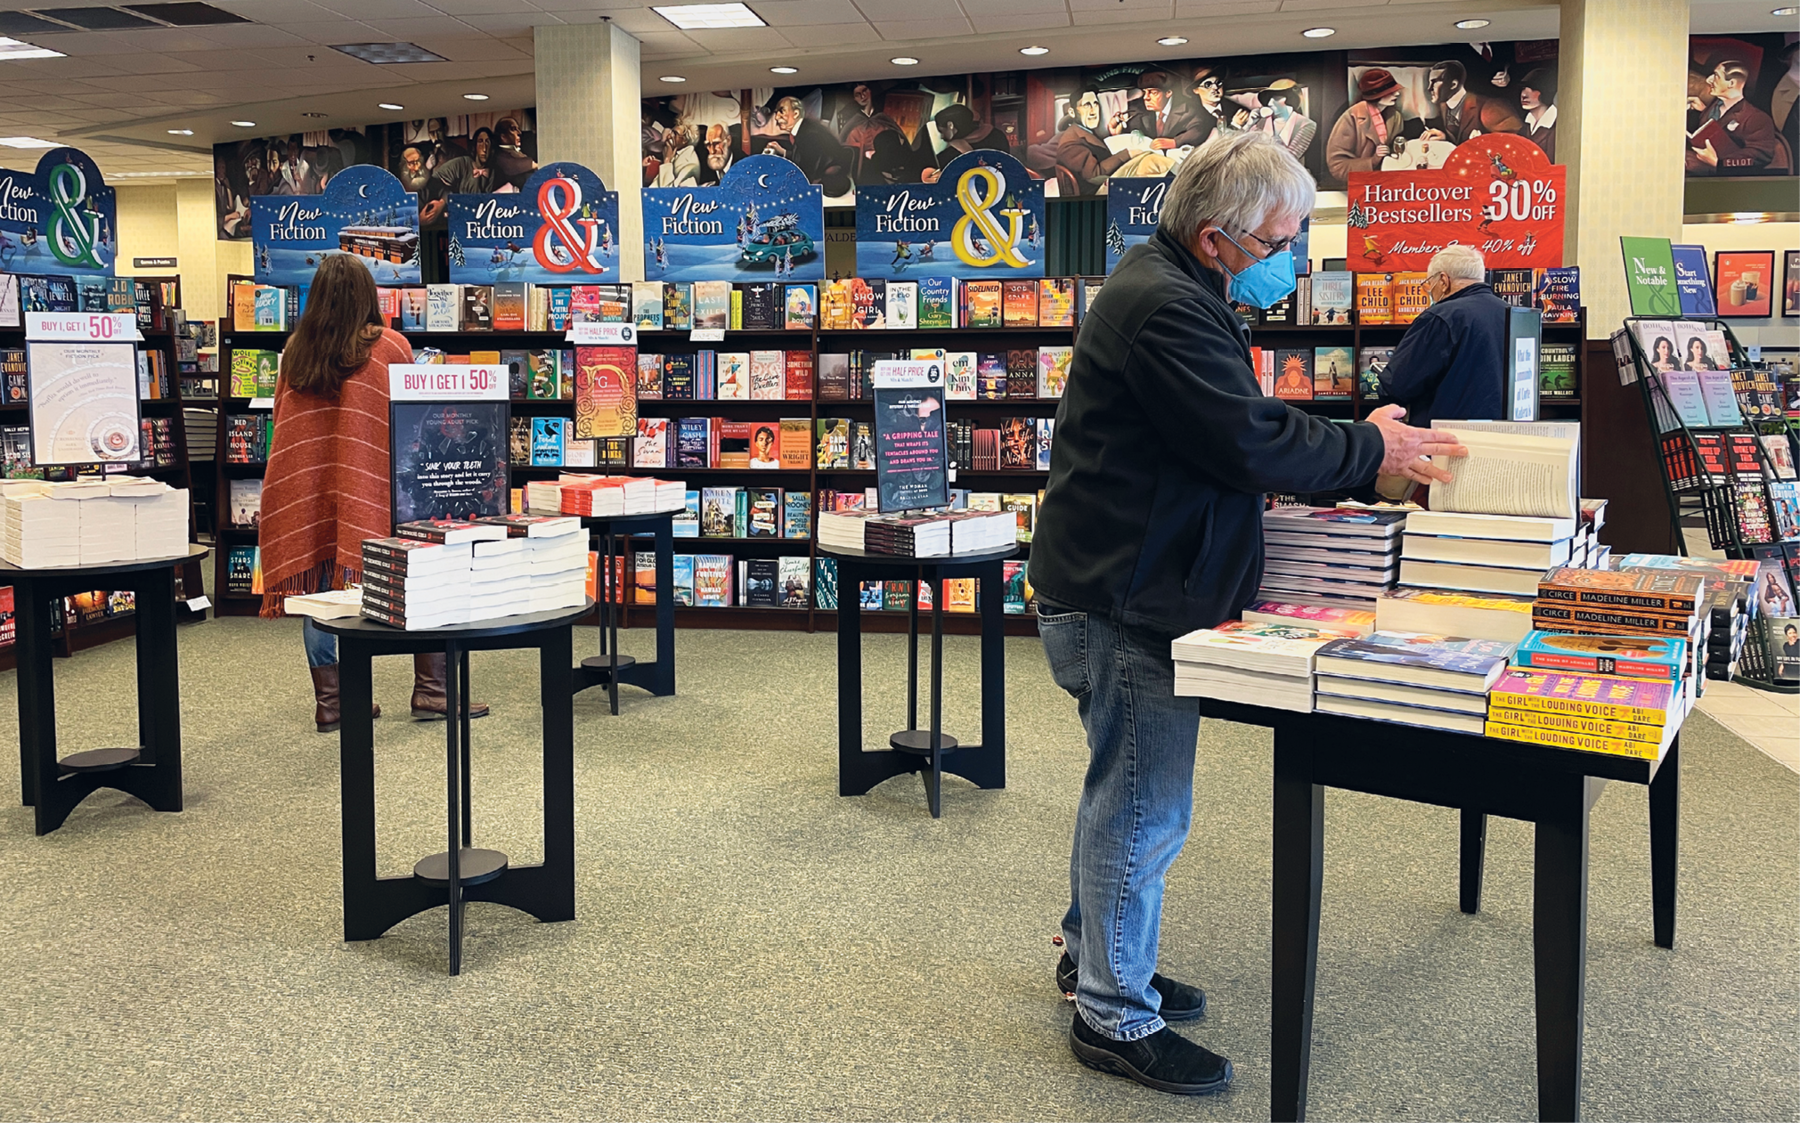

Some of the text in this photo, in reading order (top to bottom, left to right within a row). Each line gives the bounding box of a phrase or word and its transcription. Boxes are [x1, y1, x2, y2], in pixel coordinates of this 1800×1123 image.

[1726, 159, 1751, 167] ELIOT
[1364, 183, 1473, 203] Hardcover
[671, 193, 718, 223] New
[886, 190, 936, 220] New
[278, 201, 322, 232] New
[476, 199, 520, 229] New
[1364, 204, 1473, 224] Bestsellers
[1532, 205, 1556, 221] OFF
[662, 216, 723, 234] Fiction
[876, 215, 940, 233] Fiction
[270, 223, 326, 240] Fiction
[466, 222, 524, 239] Fiction
[1388, 241, 1442, 255] Members
[1482, 239, 1515, 254] 40%
[1633, 257, 1666, 275] New &
[1676, 262, 1697, 278] Start
[928, 278, 942, 287] Our
[1502, 273, 1523, 282] JANET
[1544, 275, 1577, 284] A SLOW
[1636, 276, 1668, 286] Notable
[53, 282, 69, 292] LISA
[921, 287, 950, 296] Country
[968, 285, 1000, 293] SIDELINED
[1322, 282, 1343, 292] THREE
[1367, 288, 1383, 296] LEE
[1406, 286, 1421, 295] LEE
[1494, 283, 1531, 293] EVANOVICH
[1683, 286, 1697, 294] New
[108, 294, 134, 306] ROBB
[854, 293, 884, 301] SHOW
[923, 295, 948, 304] Friends
[1319, 292, 1346, 301] SISTERS
[1400, 295, 1428, 305] CHILD
[1502, 295, 1523, 306] GAME
[1541, 292, 1579, 300] BURNING
[1361, 297, 1389, 307] CHILD
[858, 306, 880, 314] GIRL
[41, 321, 58, 332] BUY
[66, 322, 81, 332] GET
[603, 328, 618, 336] PRICE
[7, 352, 23, 362] JANET
[1553, 354, 1576, 362] LADEN
[952, 359, 968, 367] em
[892, 367, 925, 376] HALF PRICE
[404, 374, 428, 390] BUY
[437, 374, 458, 390] GET
[1758, 394, 1774, 404] GAME
[829, 436, 847, 444] CAUL
[892, 432, 922, 440] GRIPPING
[830, 444, 847, 452] BABY
[443, 461, 482, 471] YOUR TEETH
[433, 480, 454, 488] through
[1008, 504, 1028, 512] GUIDE
[1549, 591, 1662, 607] CIRCE MADELINE MILLER
[1542, 609, 1656, 627] CIRCE MADELINE MILLER
[1507, 696, 1528, 707] GIRL
[1541, 700, 1583, 714] LOUDING
[1584, 705, 1617, 717] VOICE
[1504, 712, 1525, 722] GIRL
[1538, 715, 1578, 729] LOUDING
[1581, 721, 1612, 734] VOICE
[1501, 728, 1522, 738] GIRL
[1535, 731, 1575, 745] LOUDING
[1578, 738, 1608, 750] VOICE
